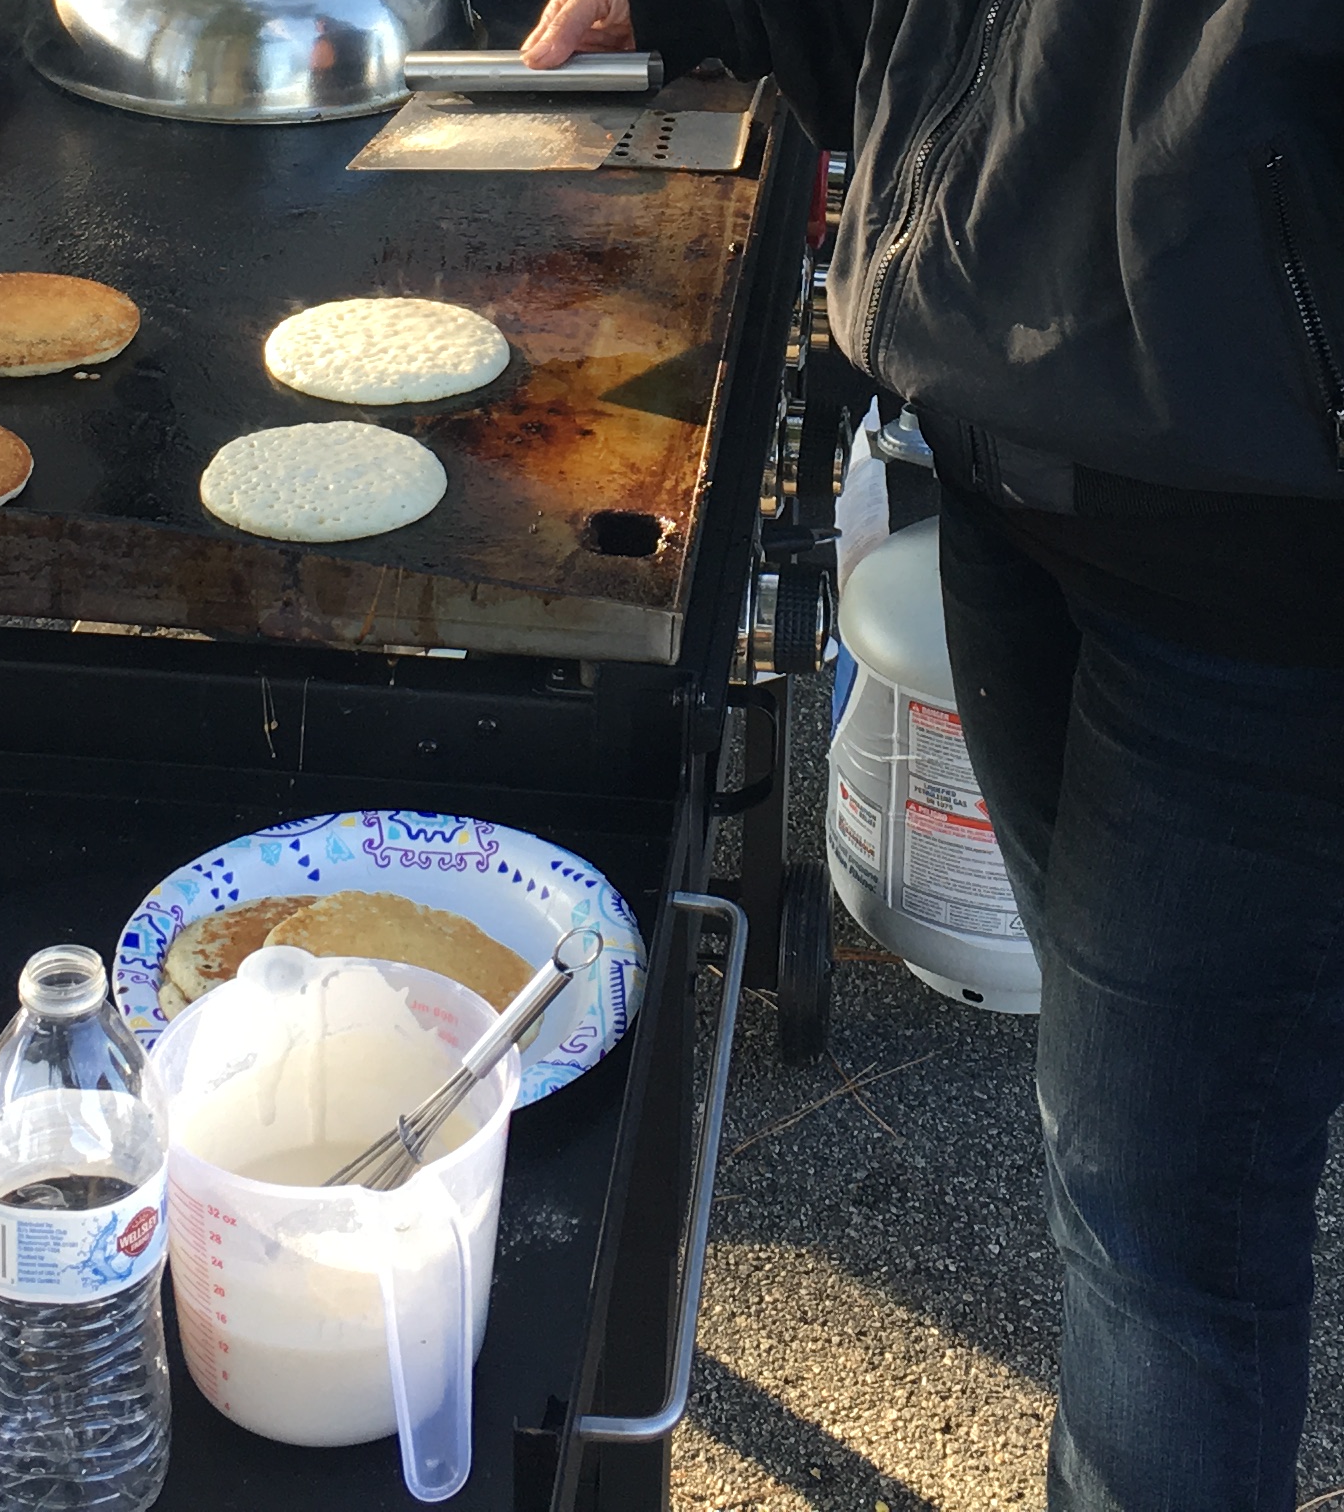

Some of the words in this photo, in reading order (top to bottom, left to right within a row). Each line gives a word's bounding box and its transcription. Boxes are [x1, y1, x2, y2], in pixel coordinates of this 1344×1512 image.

[207, 1204, 220, 1219] 32
[222, 1214, 237, 1226] oz
[119, 1212, 157, 1249] WELLSLEY
[209, 1230, 222, 1245] 28
[211, 1256, 224, 1270] 24
[213, 1284, 226, 1298] 20
[215, 1311, 227, 1324] 16
[218, 1340, 229, 1354] 12
